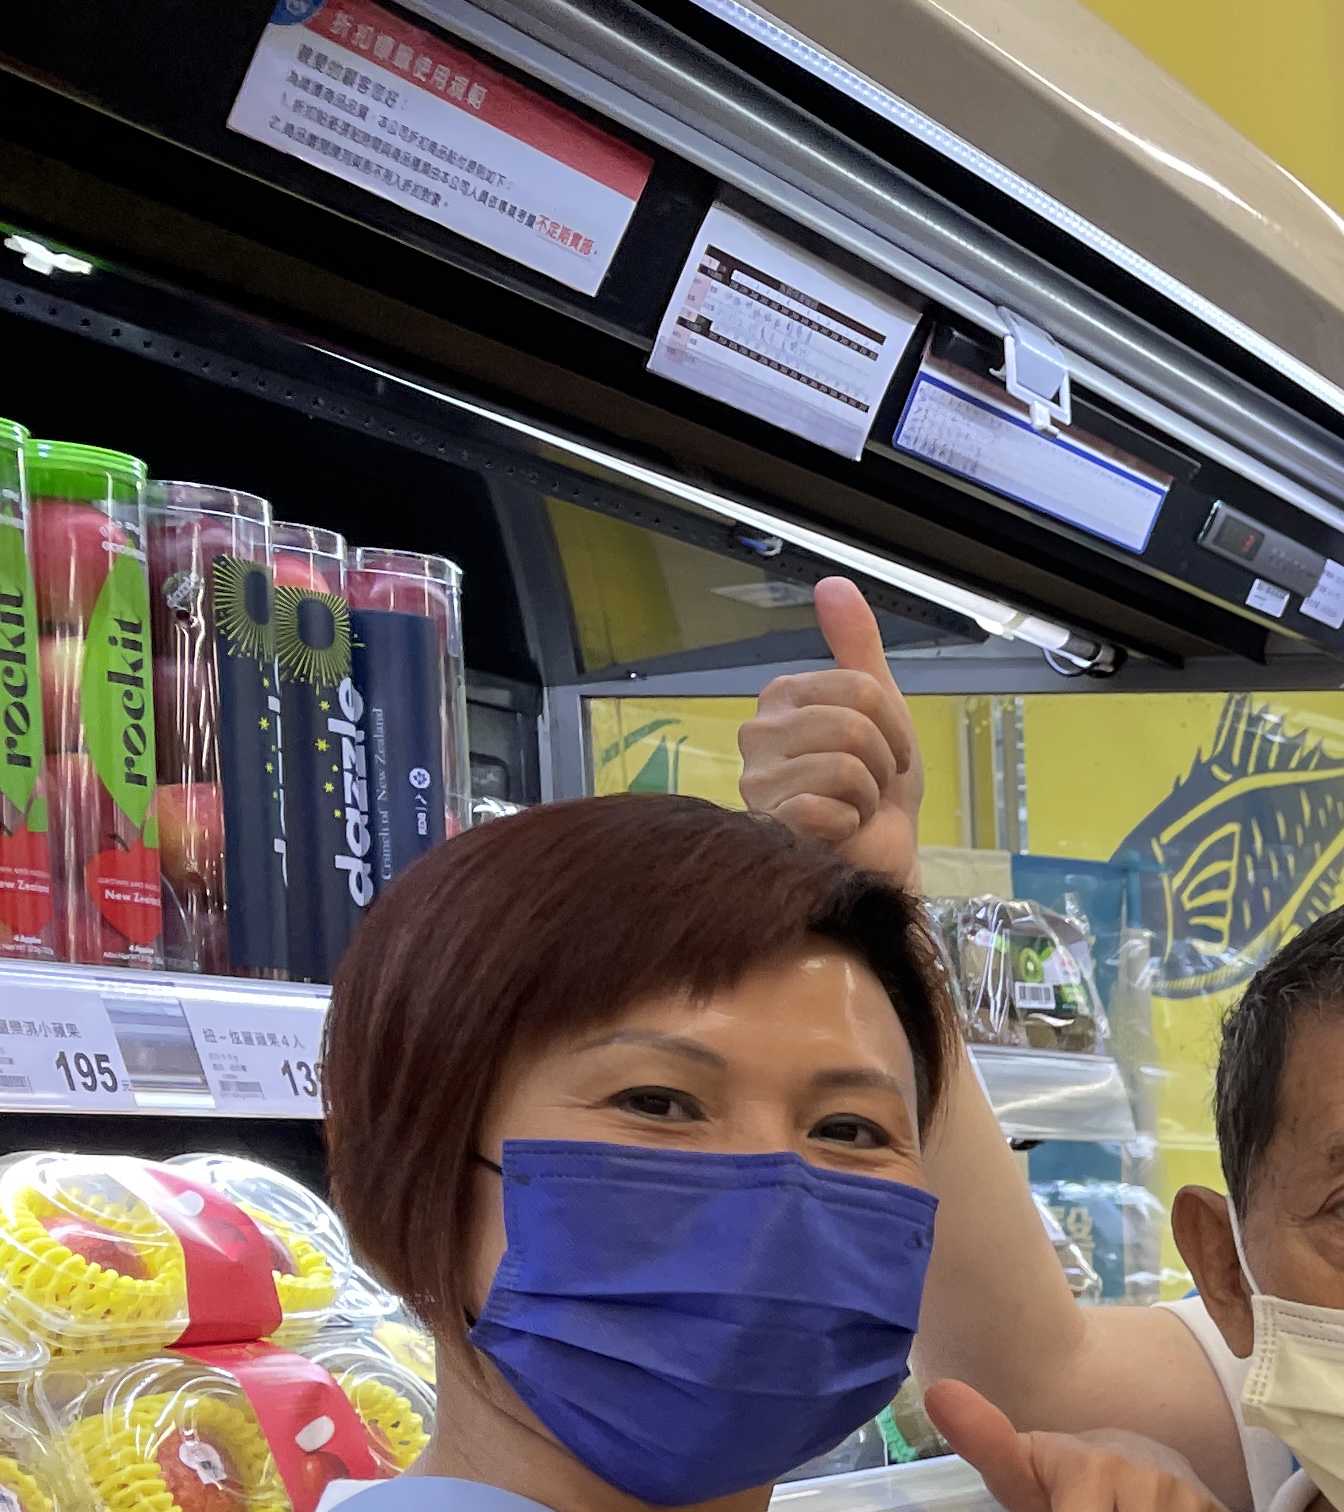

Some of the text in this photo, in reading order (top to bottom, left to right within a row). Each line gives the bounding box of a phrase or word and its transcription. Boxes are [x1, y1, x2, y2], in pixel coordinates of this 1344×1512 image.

[328, 676, 374, 908] dazzle
[55, 1050, 118, 1093] 195
[280, 1060, 325, 1098] 13
